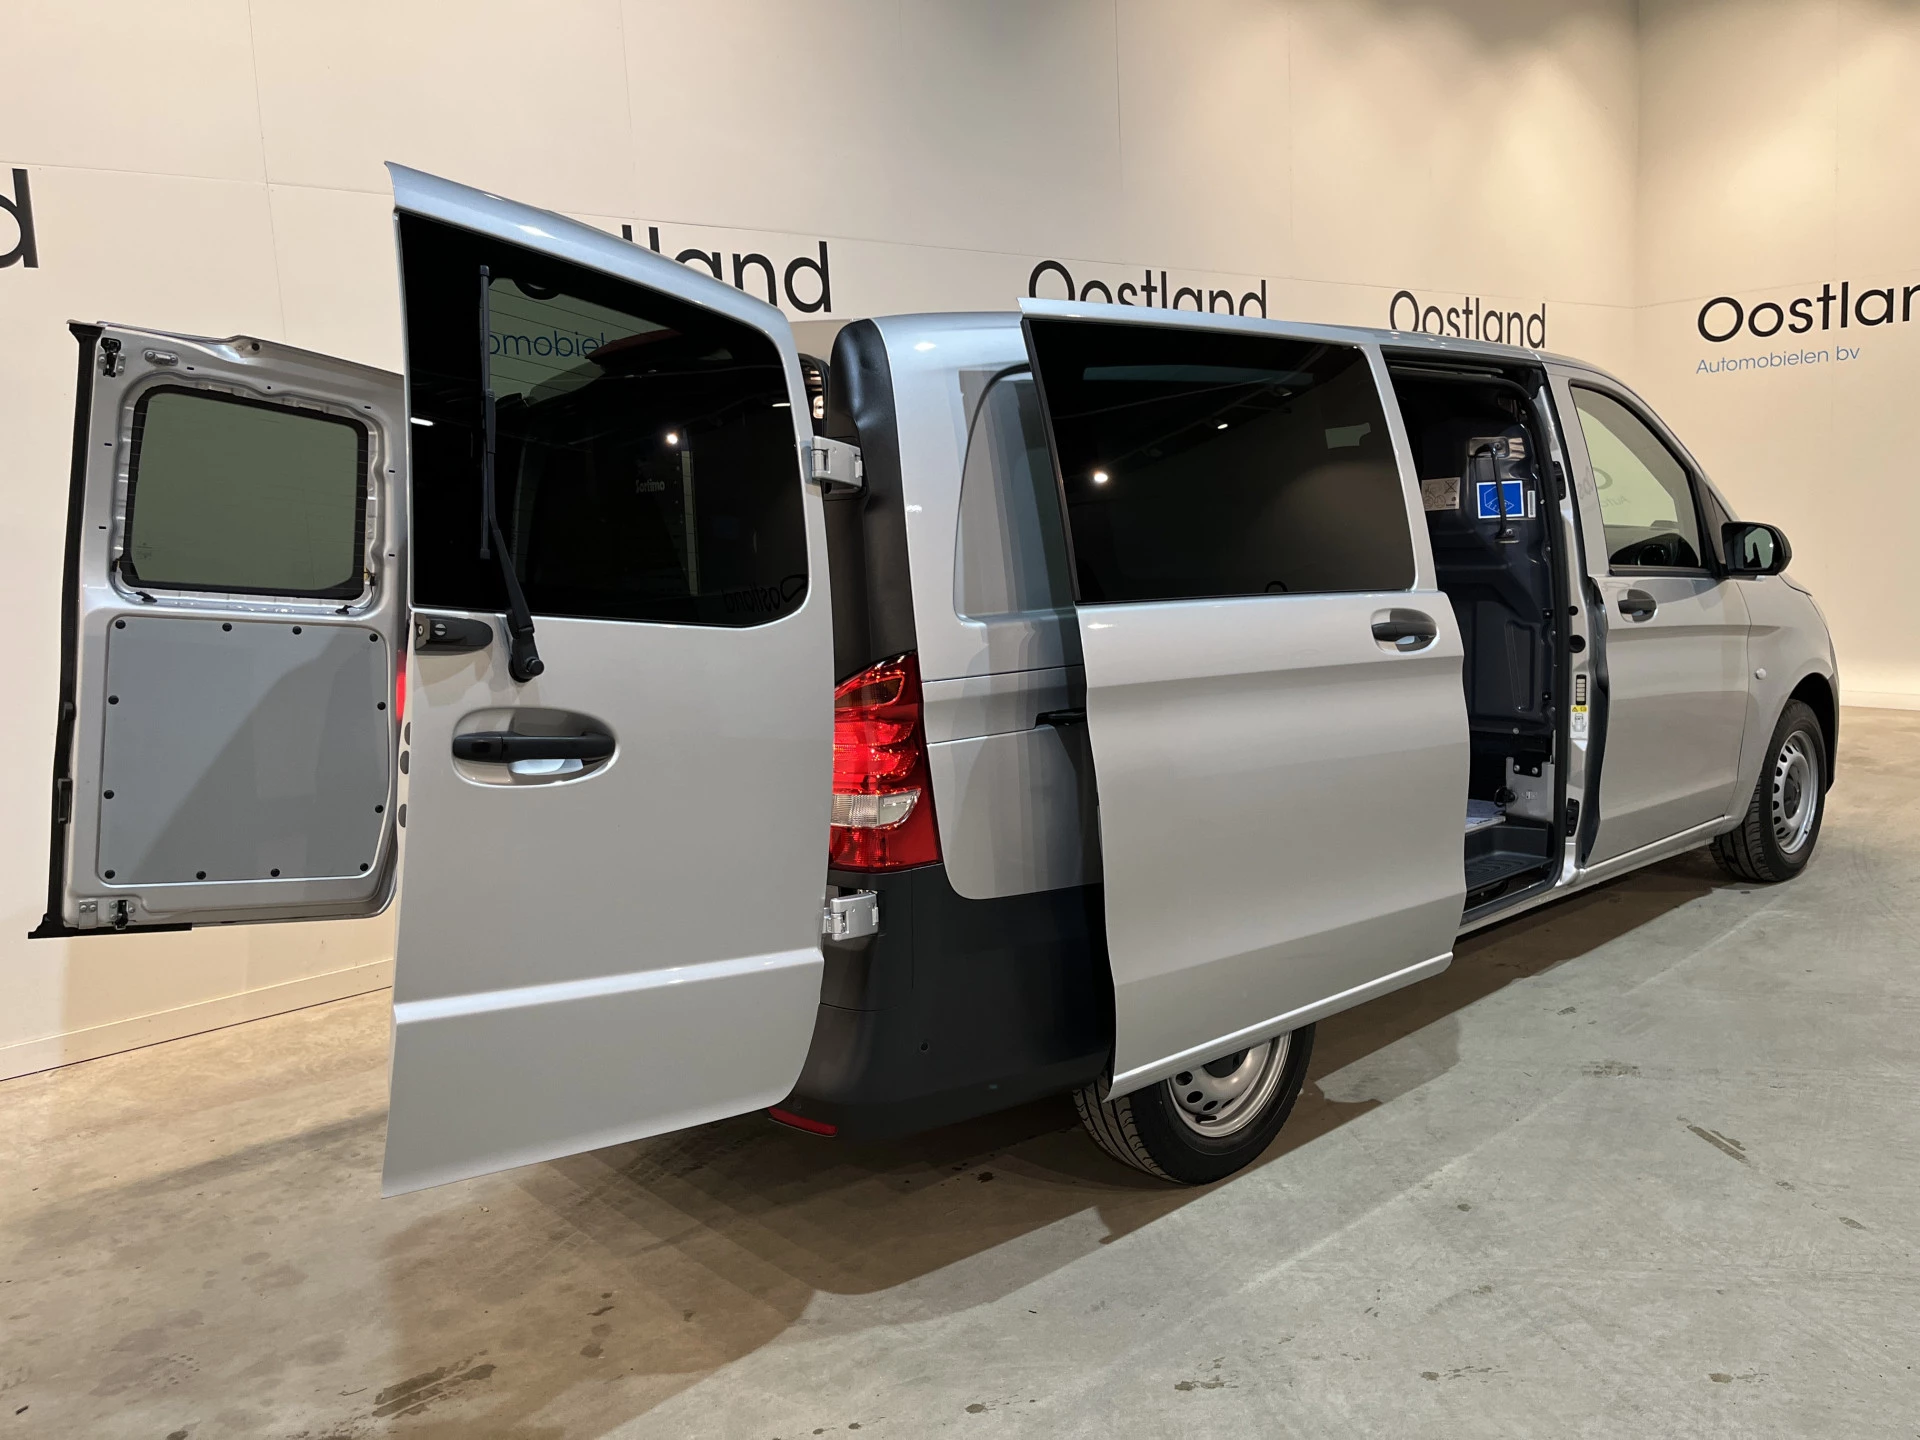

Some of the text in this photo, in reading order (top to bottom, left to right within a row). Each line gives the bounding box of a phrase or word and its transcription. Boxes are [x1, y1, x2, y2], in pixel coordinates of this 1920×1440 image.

[1028, 259, 1267, 319] Oostland
[1389, 290, 1545, 349] Oostland
[1696, 346, 1860, 374] Automobielen bv
[635, 478, 665, 494] Sortimo
